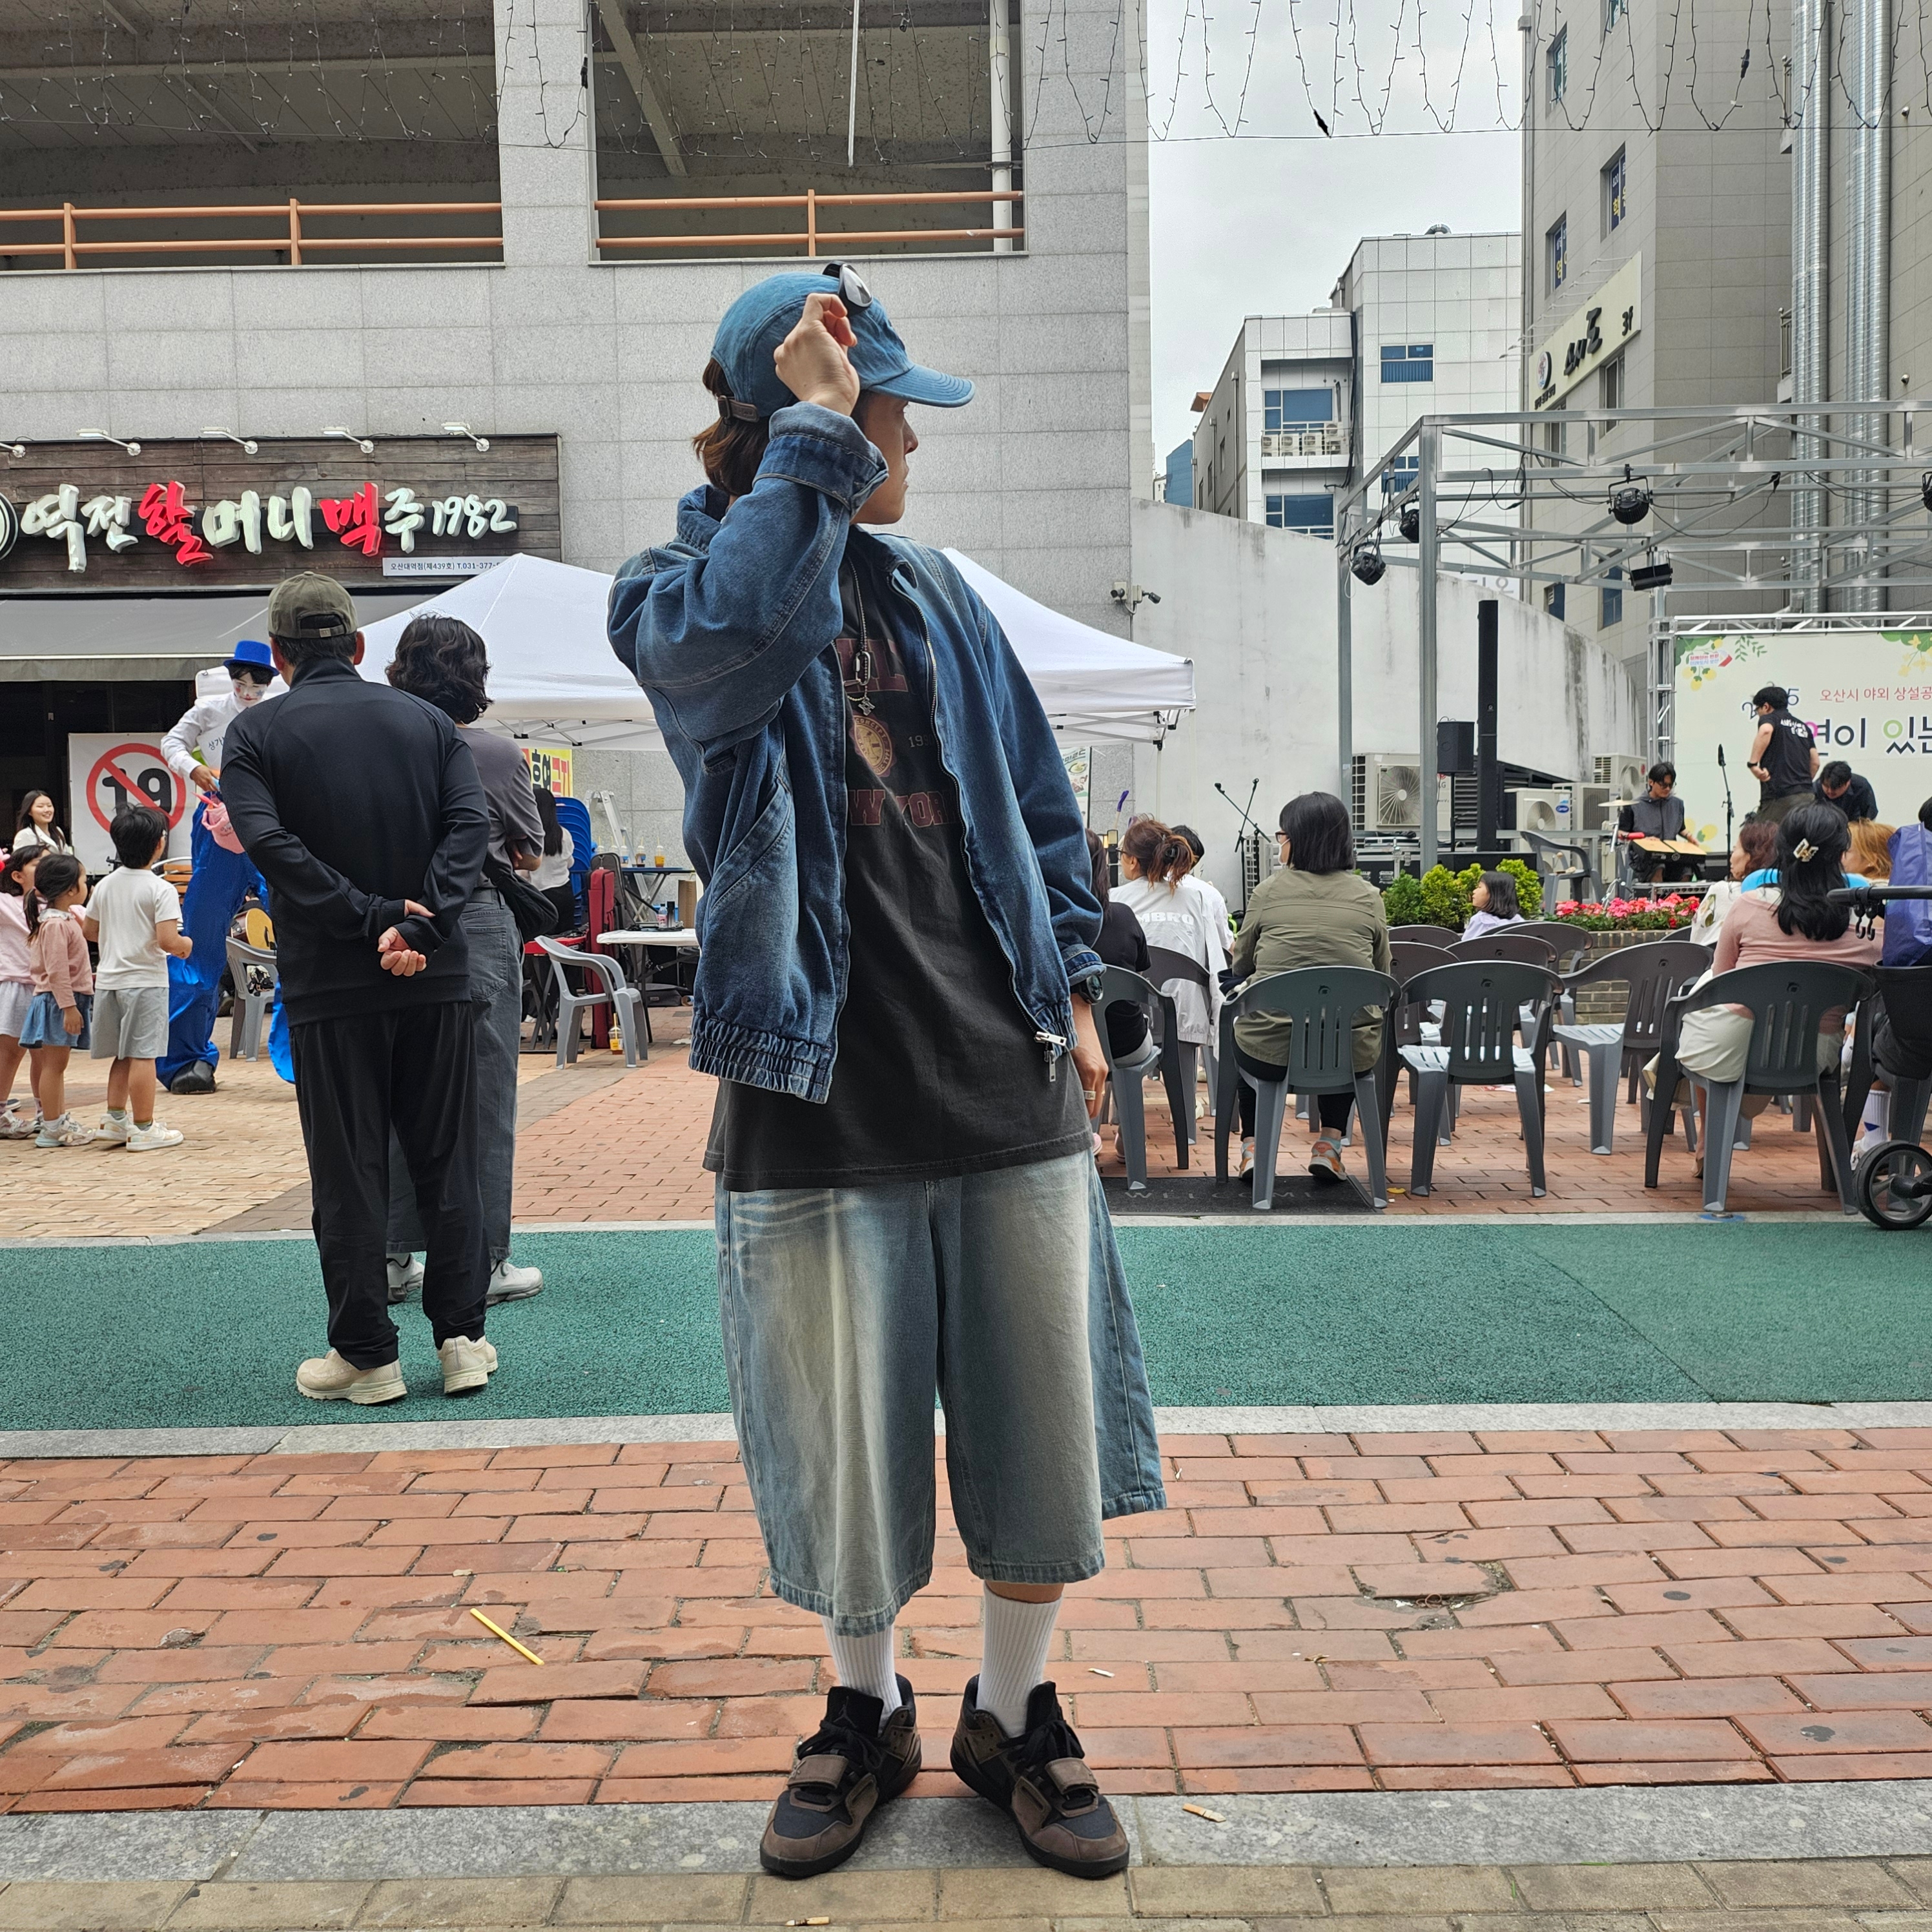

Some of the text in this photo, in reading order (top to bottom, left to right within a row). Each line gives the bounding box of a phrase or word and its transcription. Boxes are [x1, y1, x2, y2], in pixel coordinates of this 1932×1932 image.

[432, 494, 517, 540] 1982
[1820, 688, 1858, 703] 오산시
[1864, 687, 1889, 701] 야외
[209, 736, 224, 750] 상가
[102, 768, 172, 816] 19
[1140, 911, 1195, 926] MBRO
